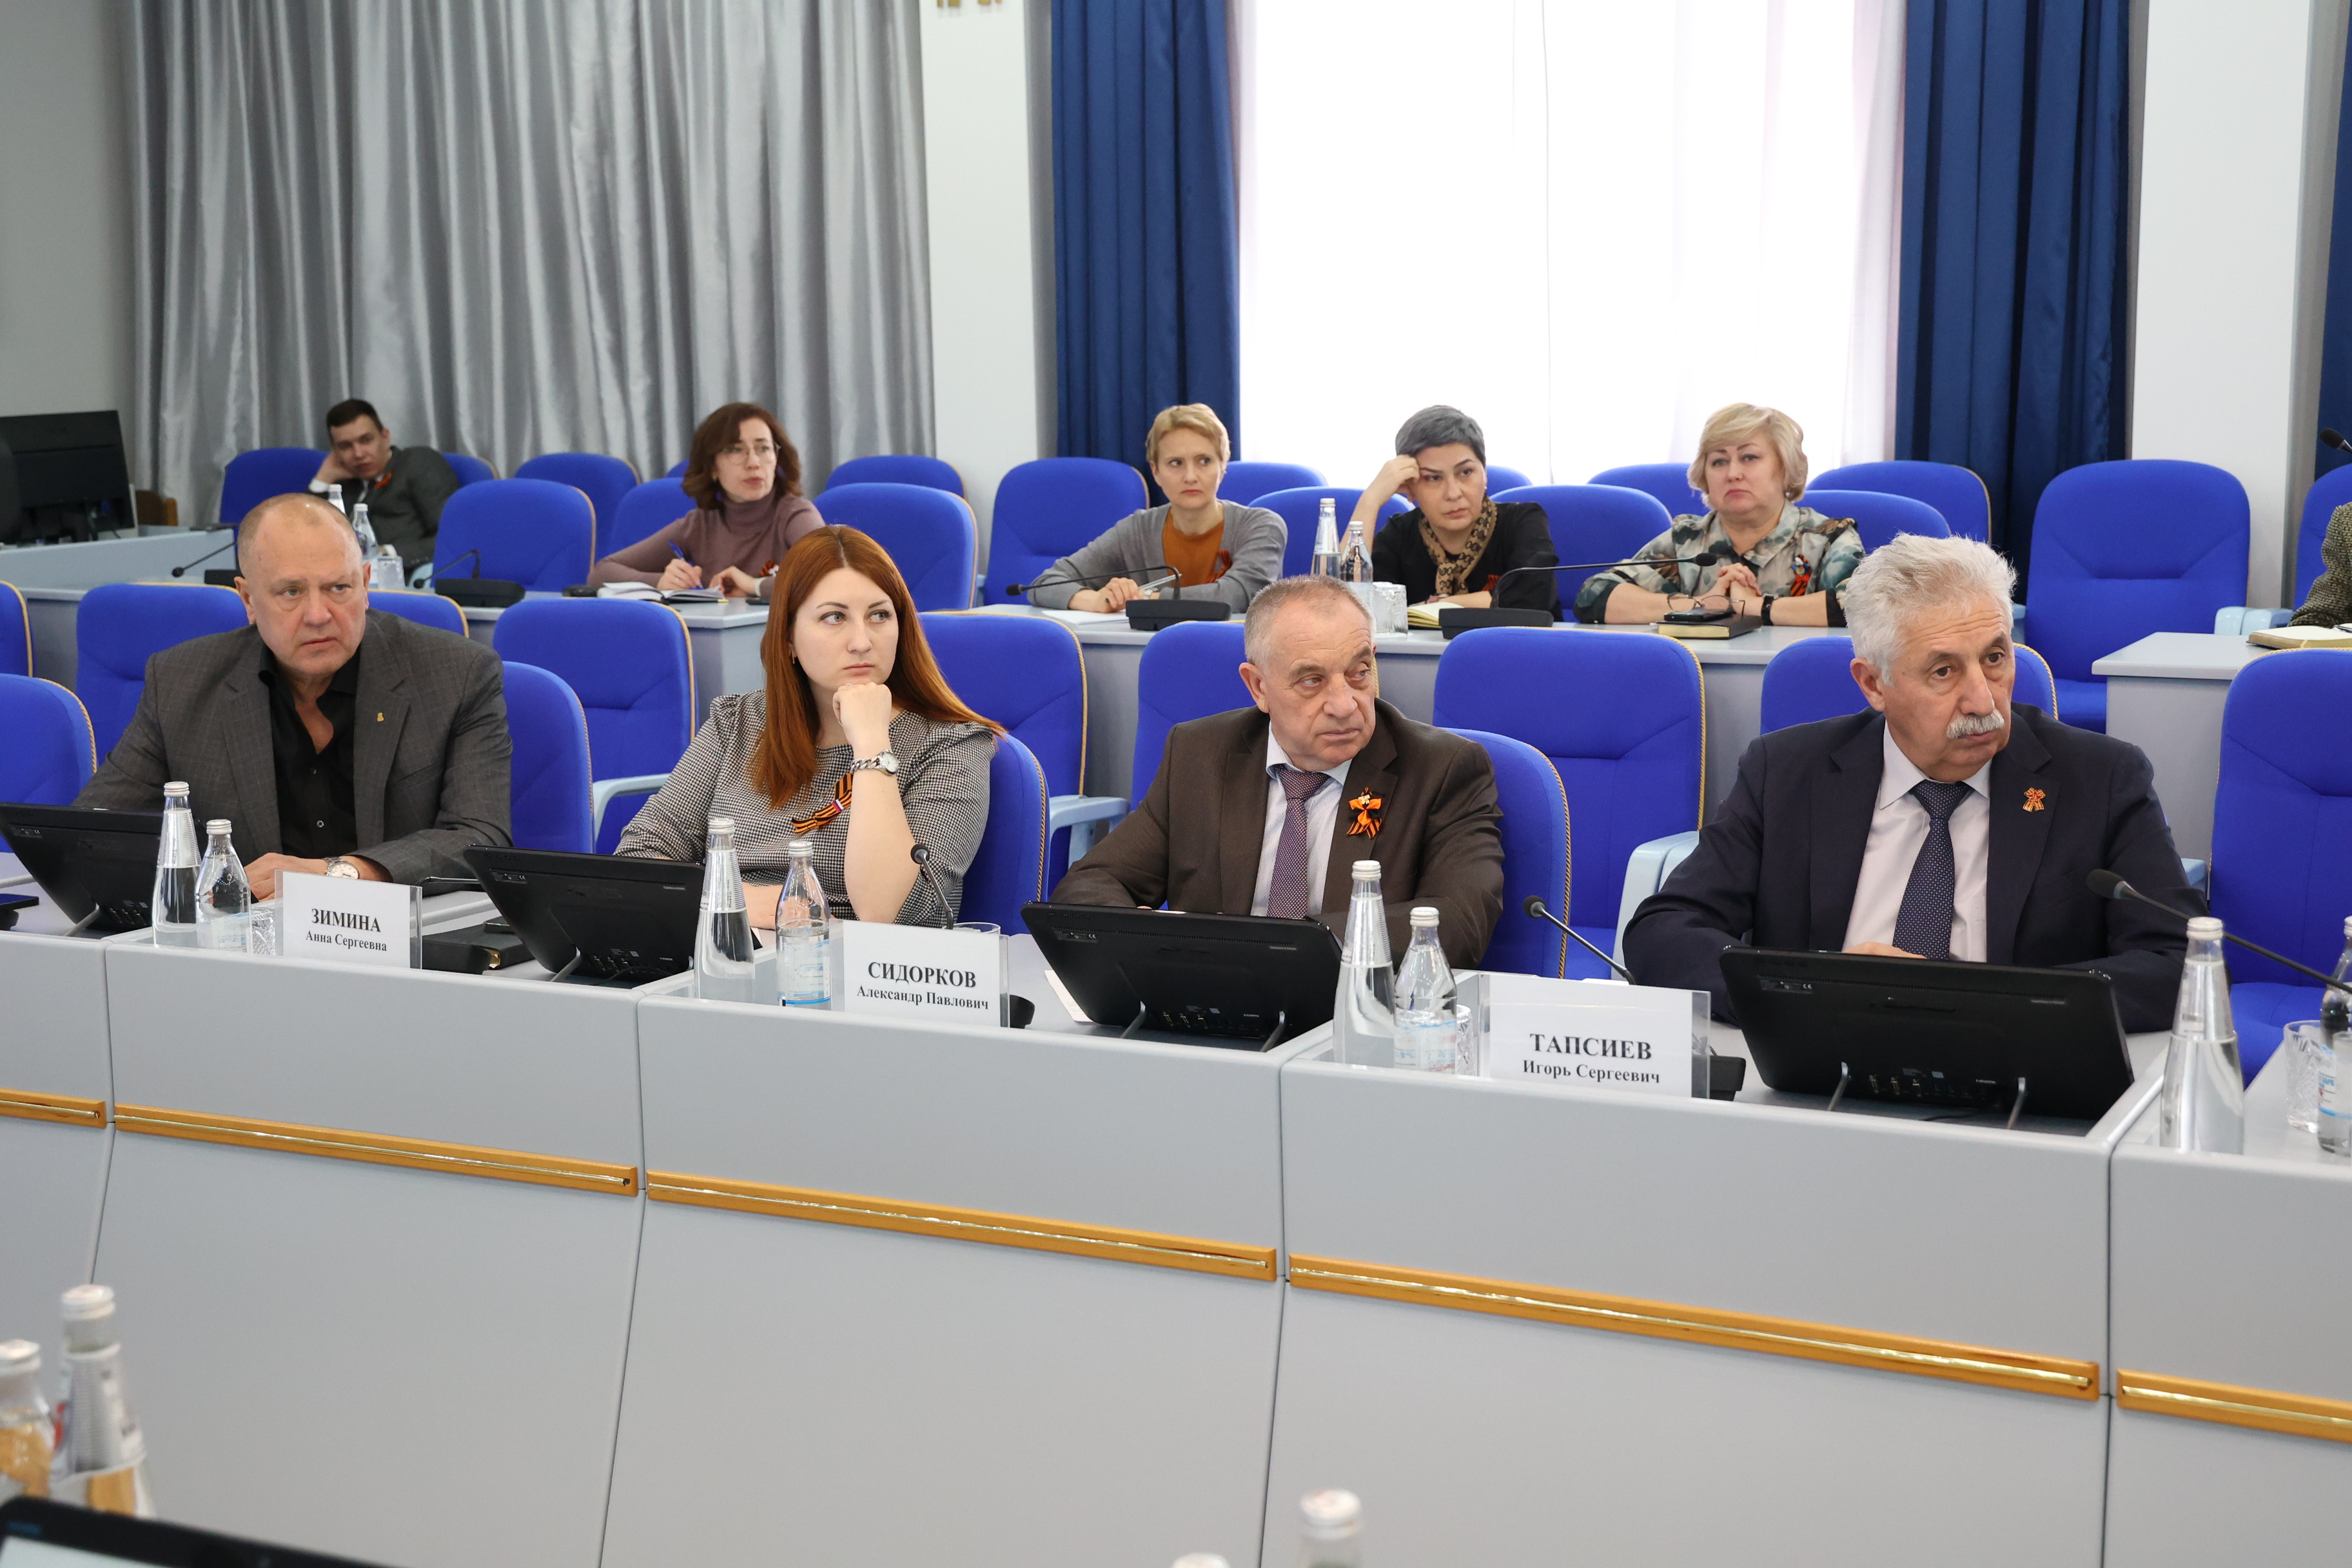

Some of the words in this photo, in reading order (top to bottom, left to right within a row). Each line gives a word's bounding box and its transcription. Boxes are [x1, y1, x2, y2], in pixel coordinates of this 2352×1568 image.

[311, 908, 381, 932] ЗИМИНА
[306, 930, 332, 943] Анна
[335, 934, 387, 951] Сергеевна
[868, 961, 976, 988] СИДОРКОВ
[857, 985, 922, 1005] Александр
[926, 992, 988, 1010] Павлович
[1530, 1034, 1652, 1060] ТАПСИЕВ
[1523, 1059, 1571, 1079] Игорь
[1576, 1064, 1660, 1083] Сергеевич
